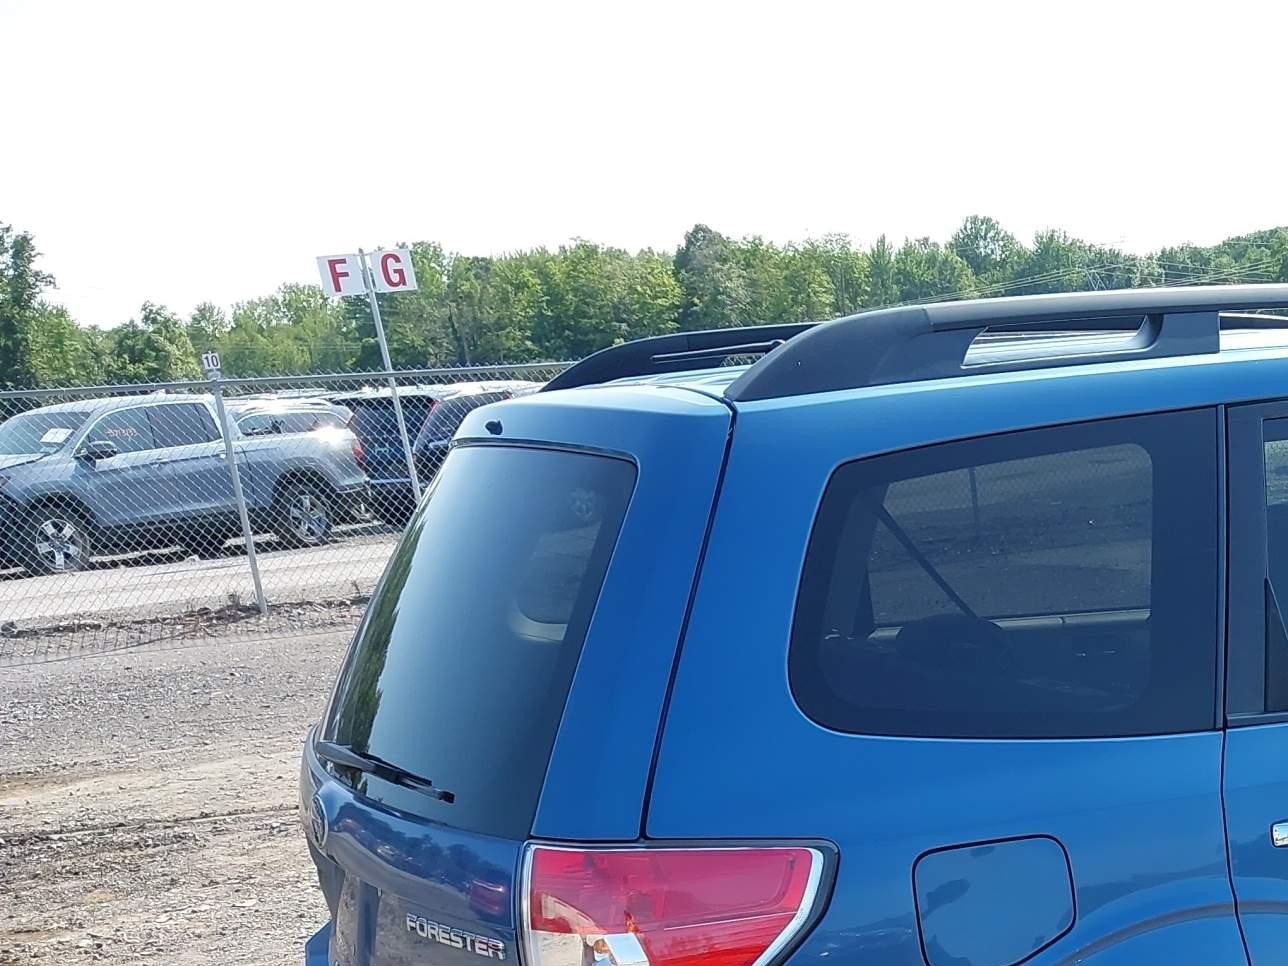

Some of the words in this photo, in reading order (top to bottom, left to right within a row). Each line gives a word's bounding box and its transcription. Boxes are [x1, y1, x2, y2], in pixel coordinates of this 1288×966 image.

[327, 258, 350, 292] F
[380, 253, 407, 288] G
[203, 354, 219, 368] 10
[406, 912, 506, 961] FORESTER
